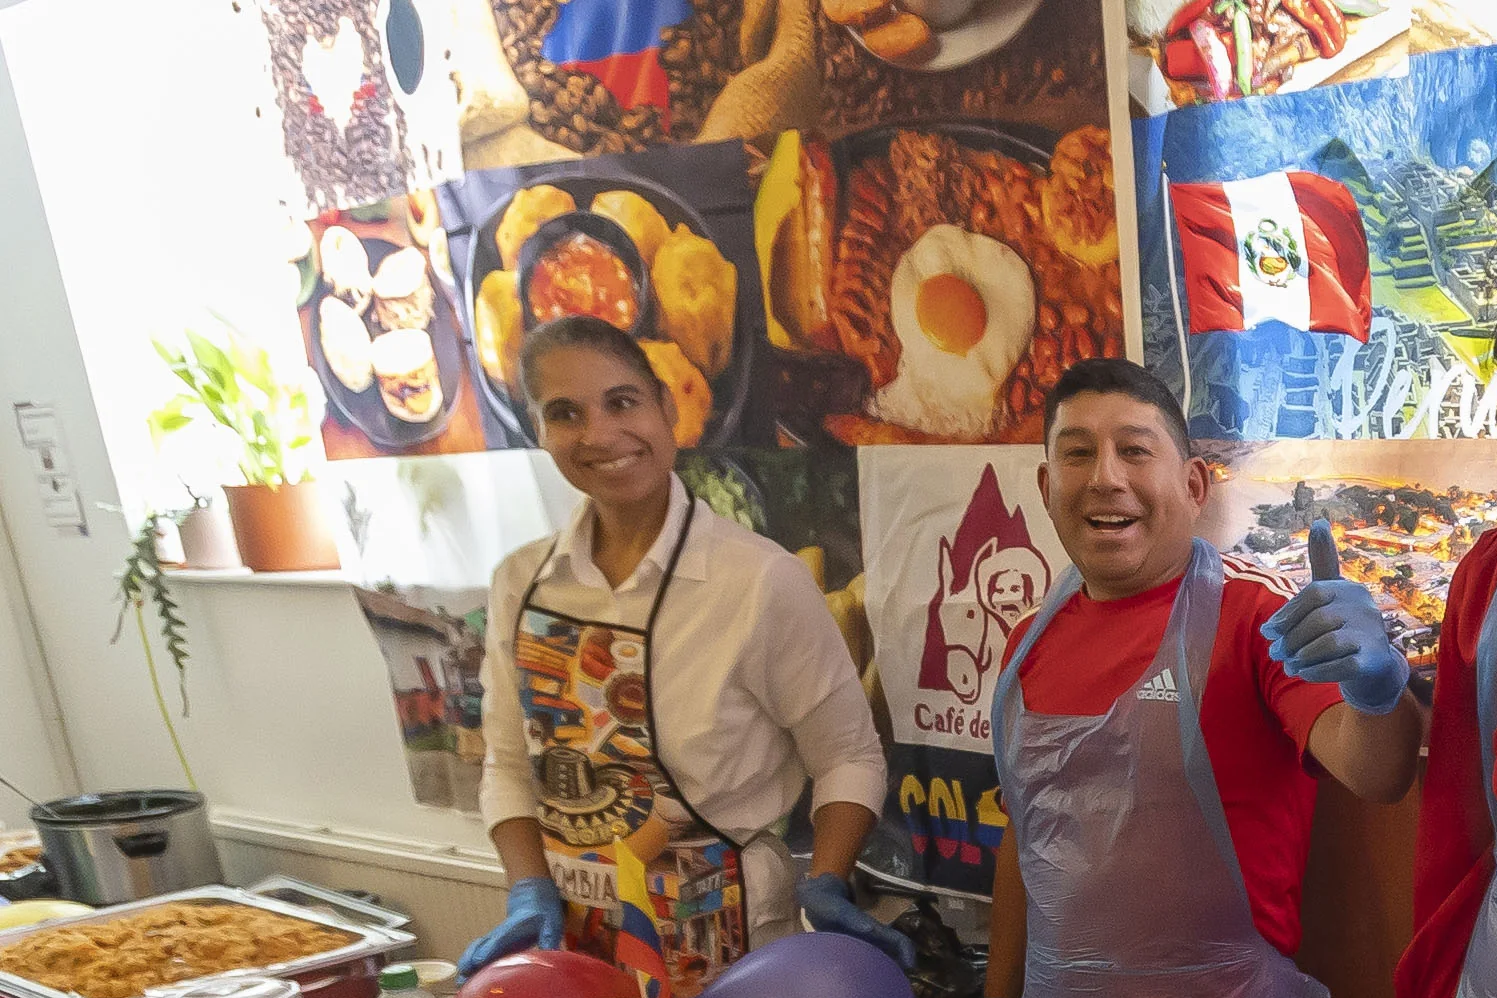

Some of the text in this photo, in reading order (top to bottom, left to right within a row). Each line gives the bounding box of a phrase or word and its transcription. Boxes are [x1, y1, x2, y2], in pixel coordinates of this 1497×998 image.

[1136, 690, 1181, 702] adidas
[914, 703, 991, 739] Café de
